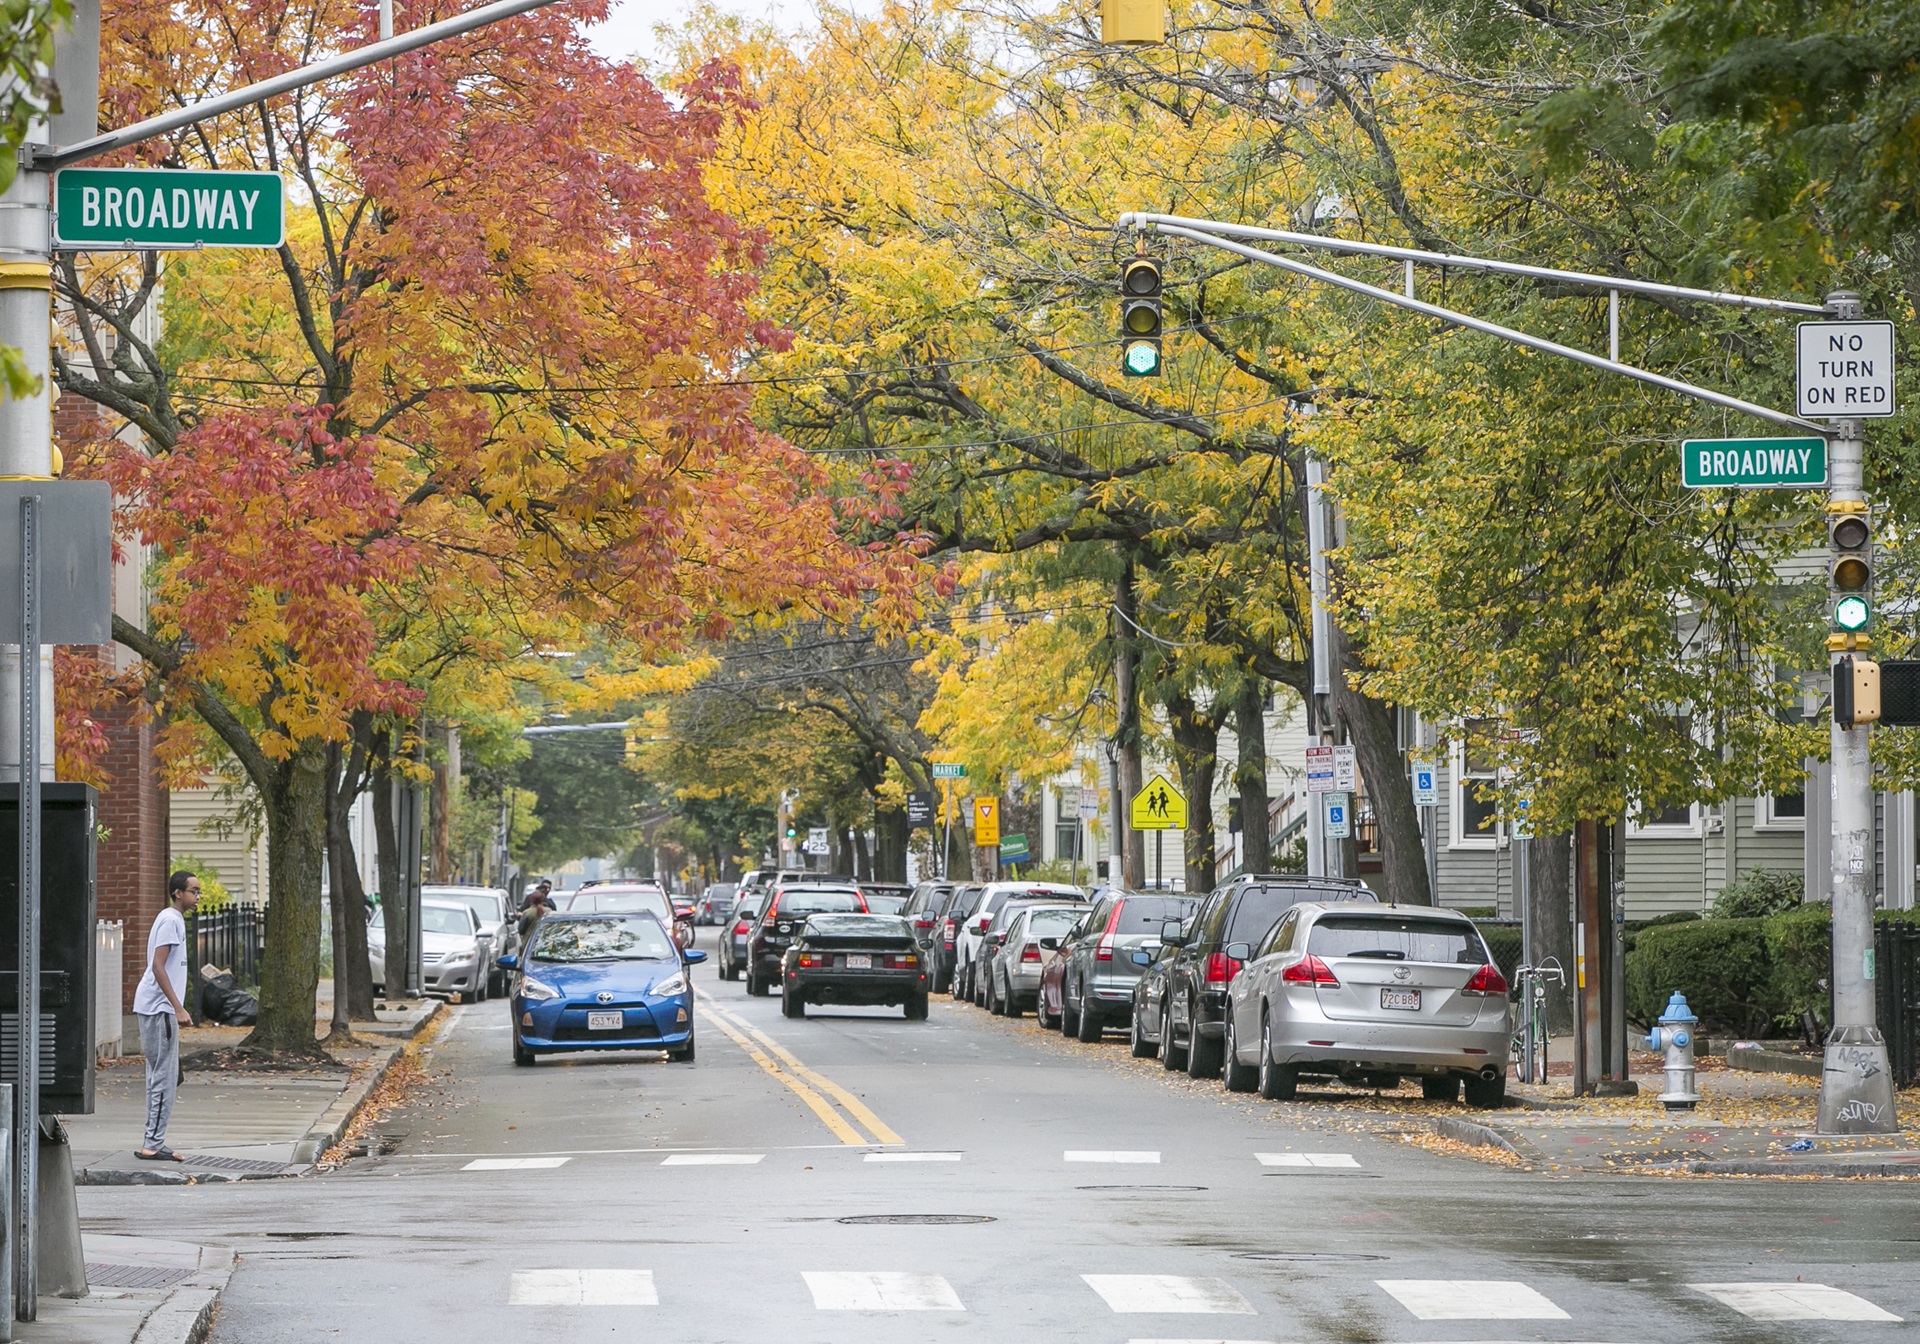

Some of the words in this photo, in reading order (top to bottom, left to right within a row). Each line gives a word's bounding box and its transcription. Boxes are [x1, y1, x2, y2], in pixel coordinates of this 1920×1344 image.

[82, 186, 260, 230] BROADWAY
[1829, 335, 1863, 352] NO
[1819, 360, 1874, 378] TURN
[1807, 387, 1836, 404] ON
[1845, 386, 1886, 403] RED
[1699, 448, 1812, 477] BROADWAY
[935, 765, 961, 776] MARKET
[1337, 760, 1352, 768] PERMIT
[812, 841, 827, 852] 25
[1383, 994, 1400, 1005] 72C
[590, 1017, 605, 1026] 453
[606, 1016, 620, 1026] YV4
